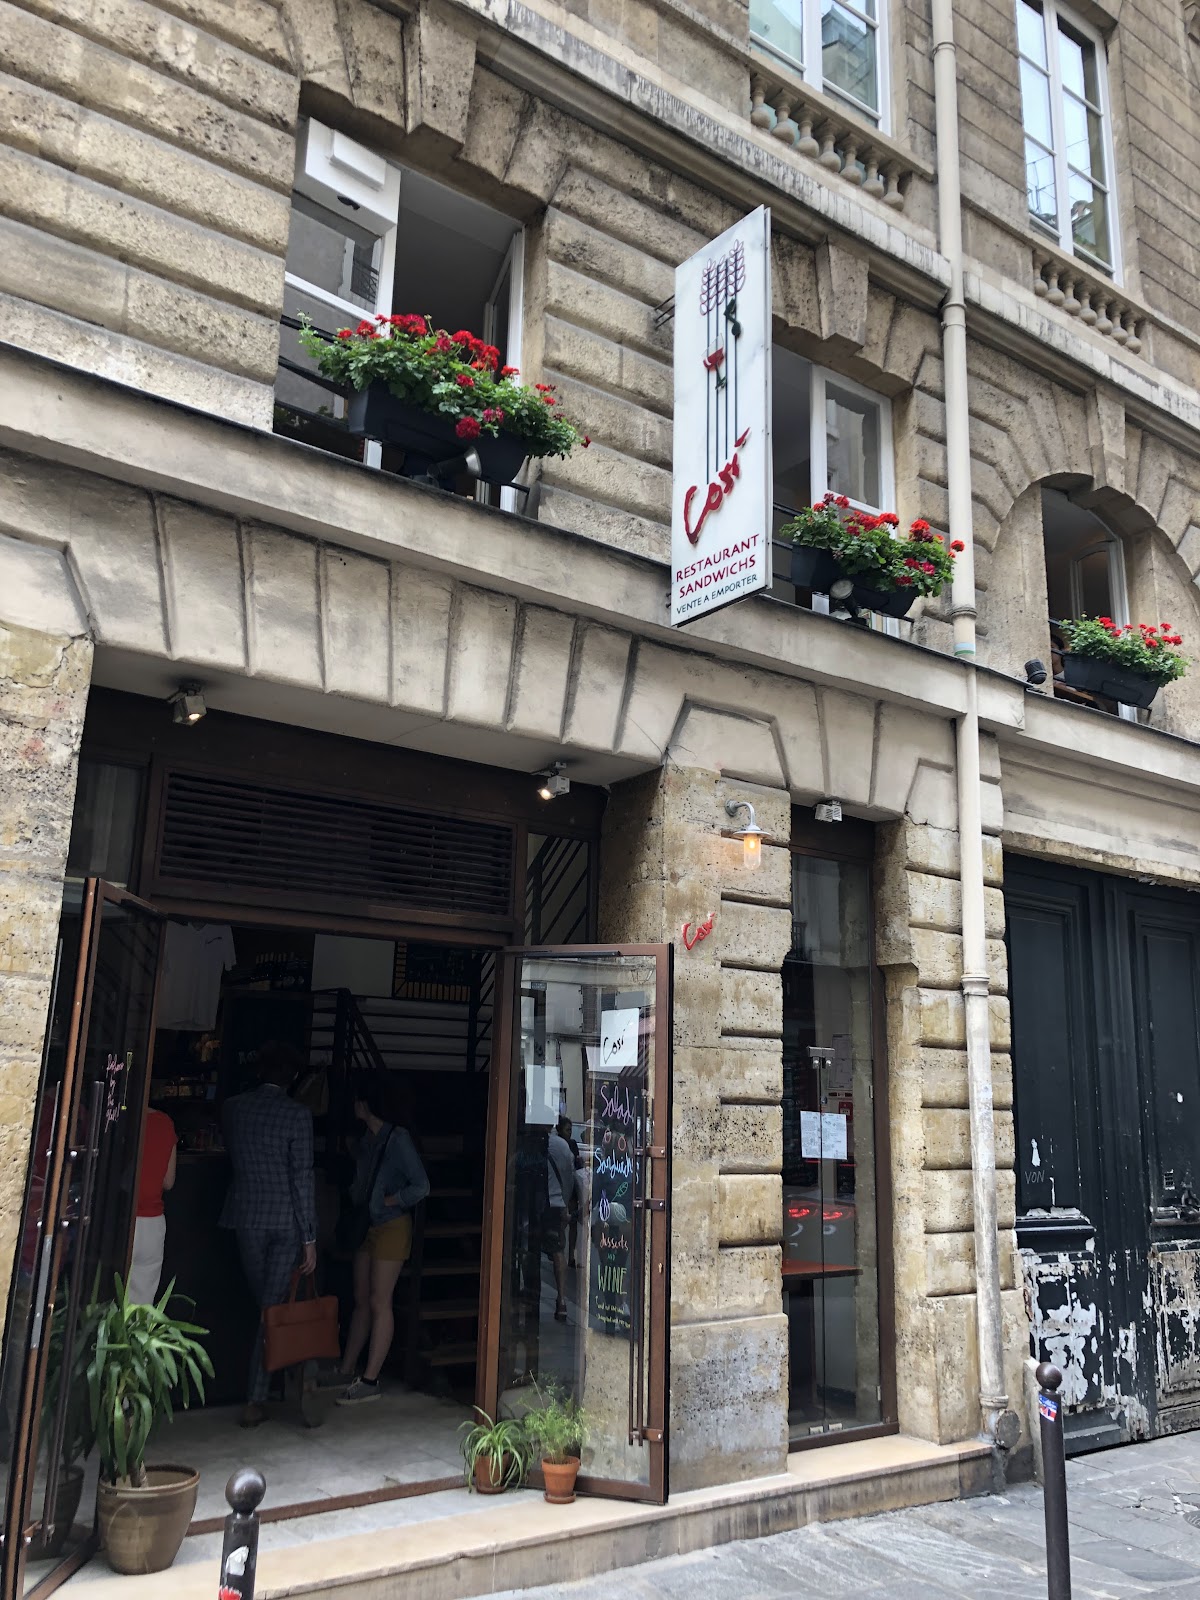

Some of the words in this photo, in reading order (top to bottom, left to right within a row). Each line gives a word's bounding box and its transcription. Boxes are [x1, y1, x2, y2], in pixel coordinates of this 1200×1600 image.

[676, 533, 760, 583] RESTAURANT
[679, 554, 756, 599] SANDWICHS
[676, 597, 702, 615] VENTE
[703, 594, 710, 605] A
[711, 573, 758, 600] EMPORTER
[1024, 1169, 1045, 1185] VON
[597, 1264, 628, 1295] WINE
